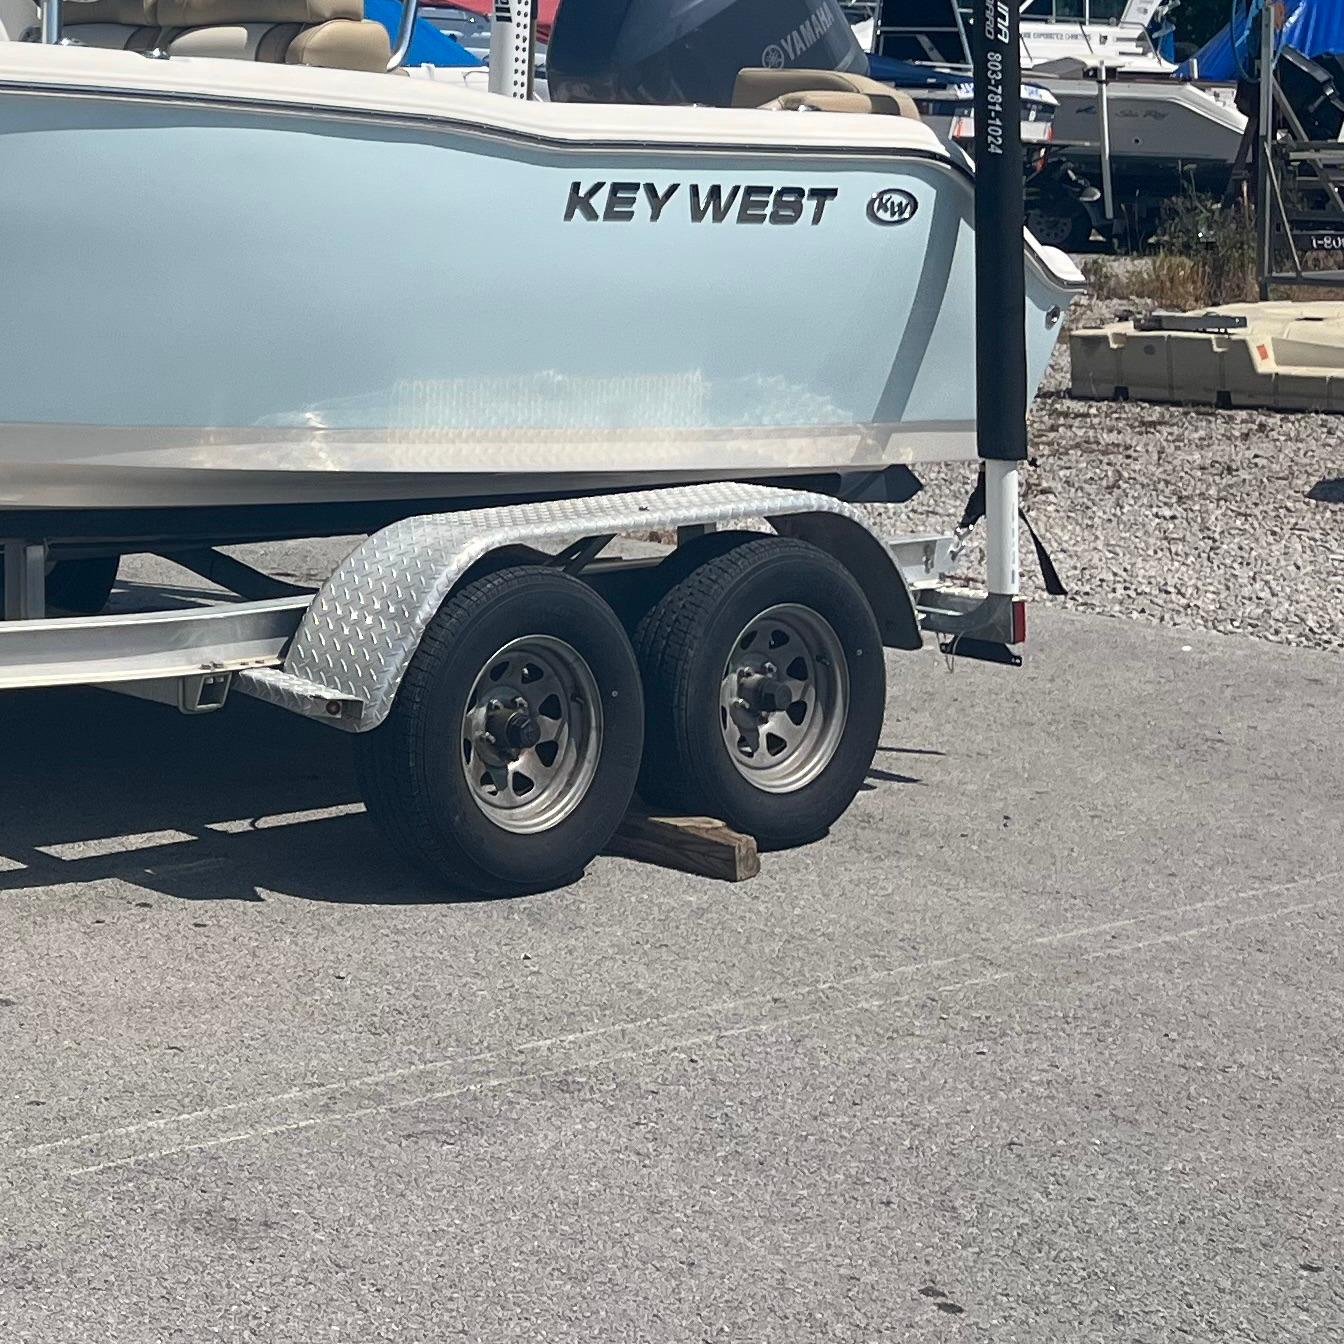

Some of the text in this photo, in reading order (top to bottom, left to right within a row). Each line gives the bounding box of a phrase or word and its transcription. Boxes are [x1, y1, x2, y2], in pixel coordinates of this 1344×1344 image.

[779, 1, 835, 61] YAMAHA
[986, 52, 1004, 155] 803-781-1024
[563, 181, 839, 226] KEY WEST
[1311, 236, 1344, 249] 1-80
